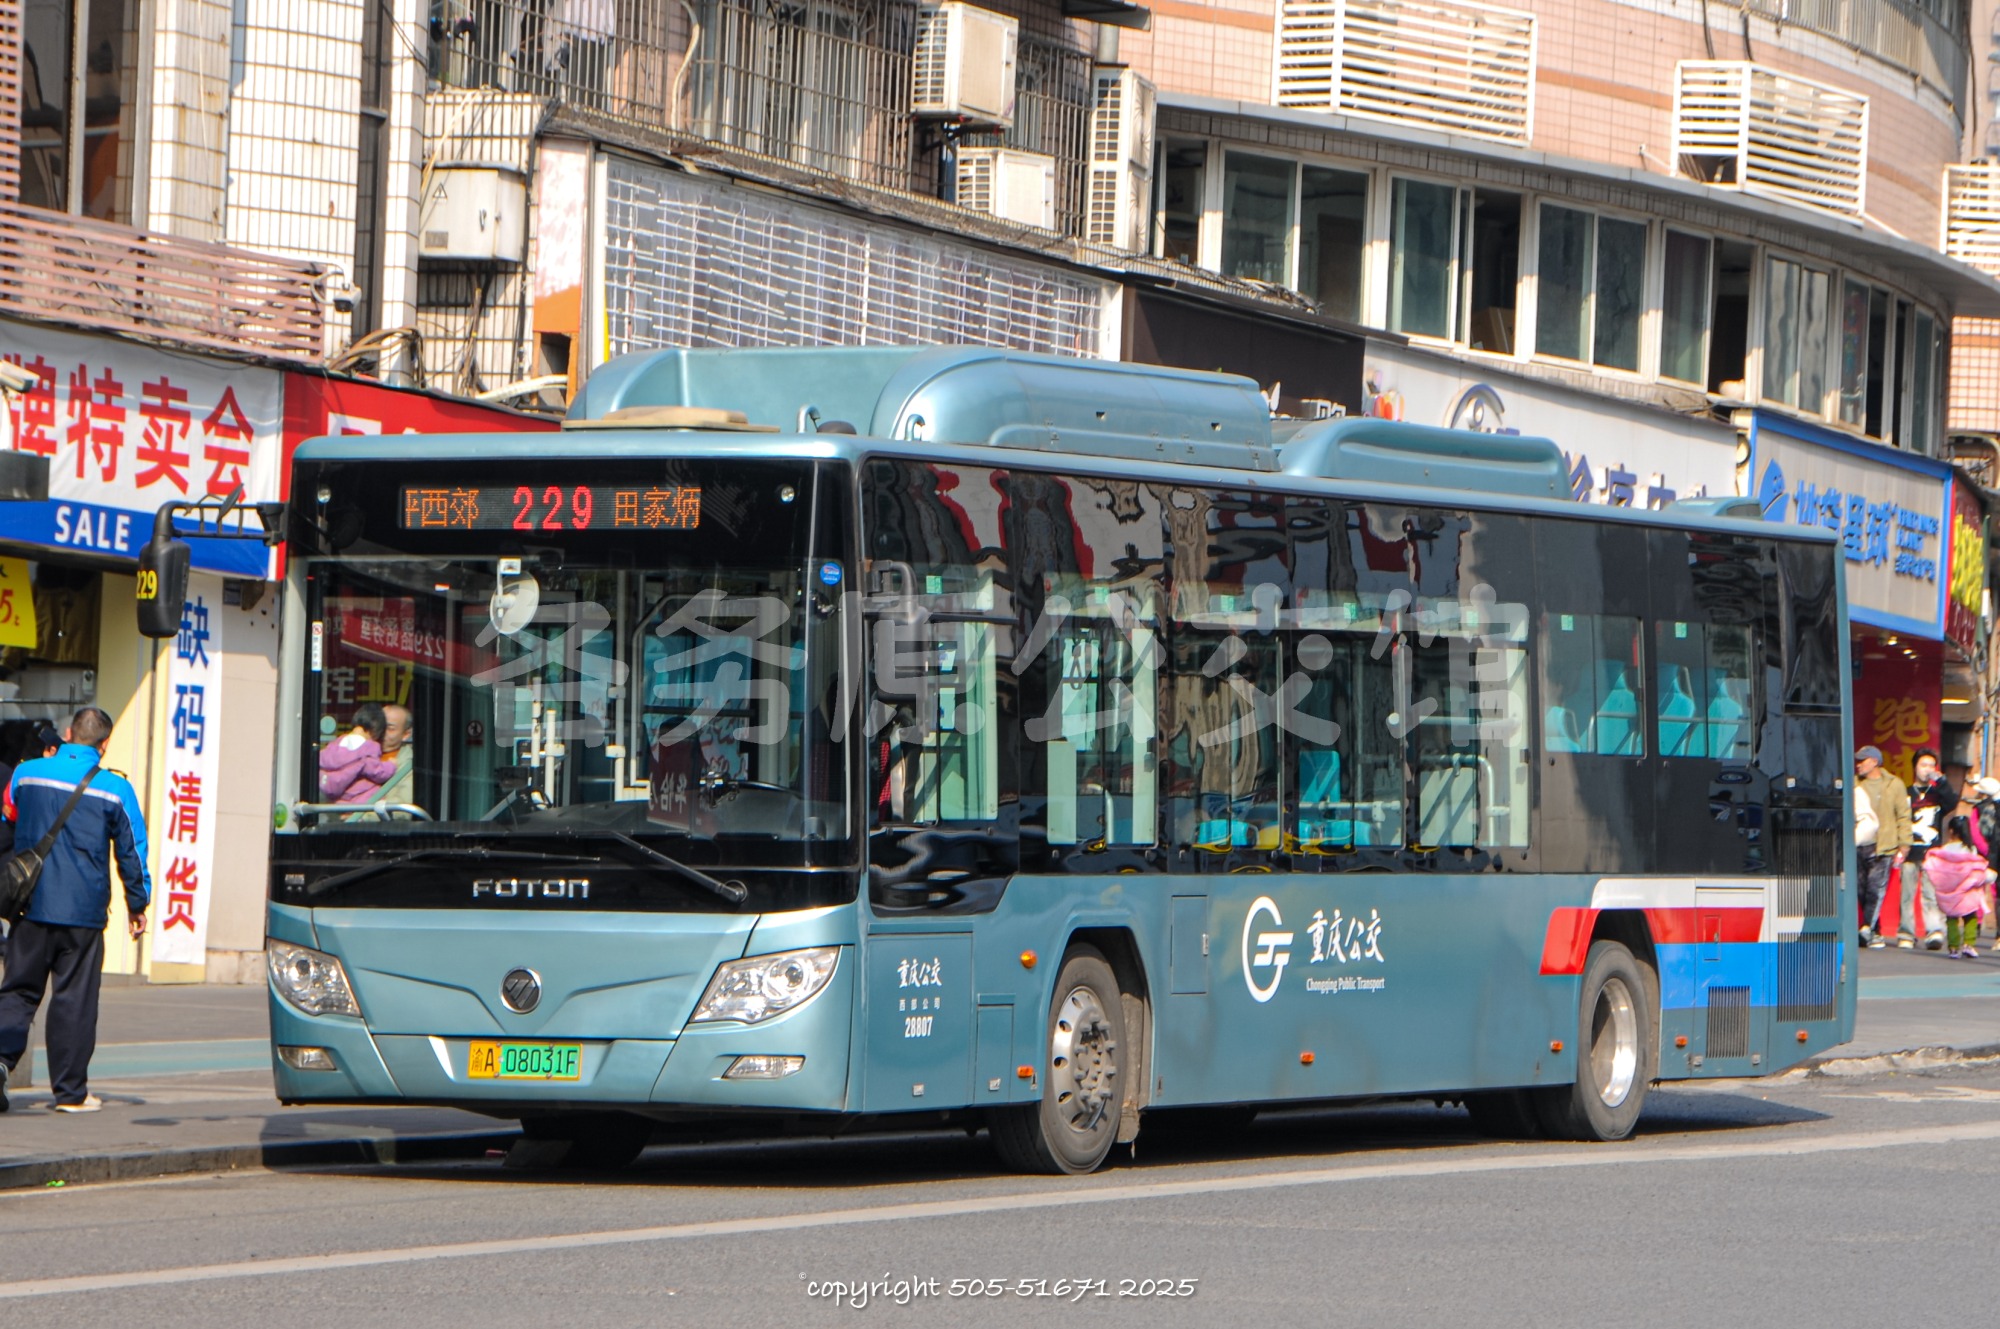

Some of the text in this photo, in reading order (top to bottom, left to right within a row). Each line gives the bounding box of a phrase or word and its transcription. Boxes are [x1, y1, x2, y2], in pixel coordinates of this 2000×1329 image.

[512, 486, 592, 530] 229
[614, 486, 702, 529] 田家炳
[54, 505, 130, 551] SALE
[162, 595, 210, 933] 缺码清货
[472, 878, 590, 899] FOTON
[1306, 908, 1385, 964] 重庆公交
[897, 957, 943, 988] 重庆公交
[1338, 977, 1356, 991] Public
[1357, 976, 1385, 992] Transport
[905, 1016, 934, 1038] 28807
[505, 1048, 578, 1074] 08031F
